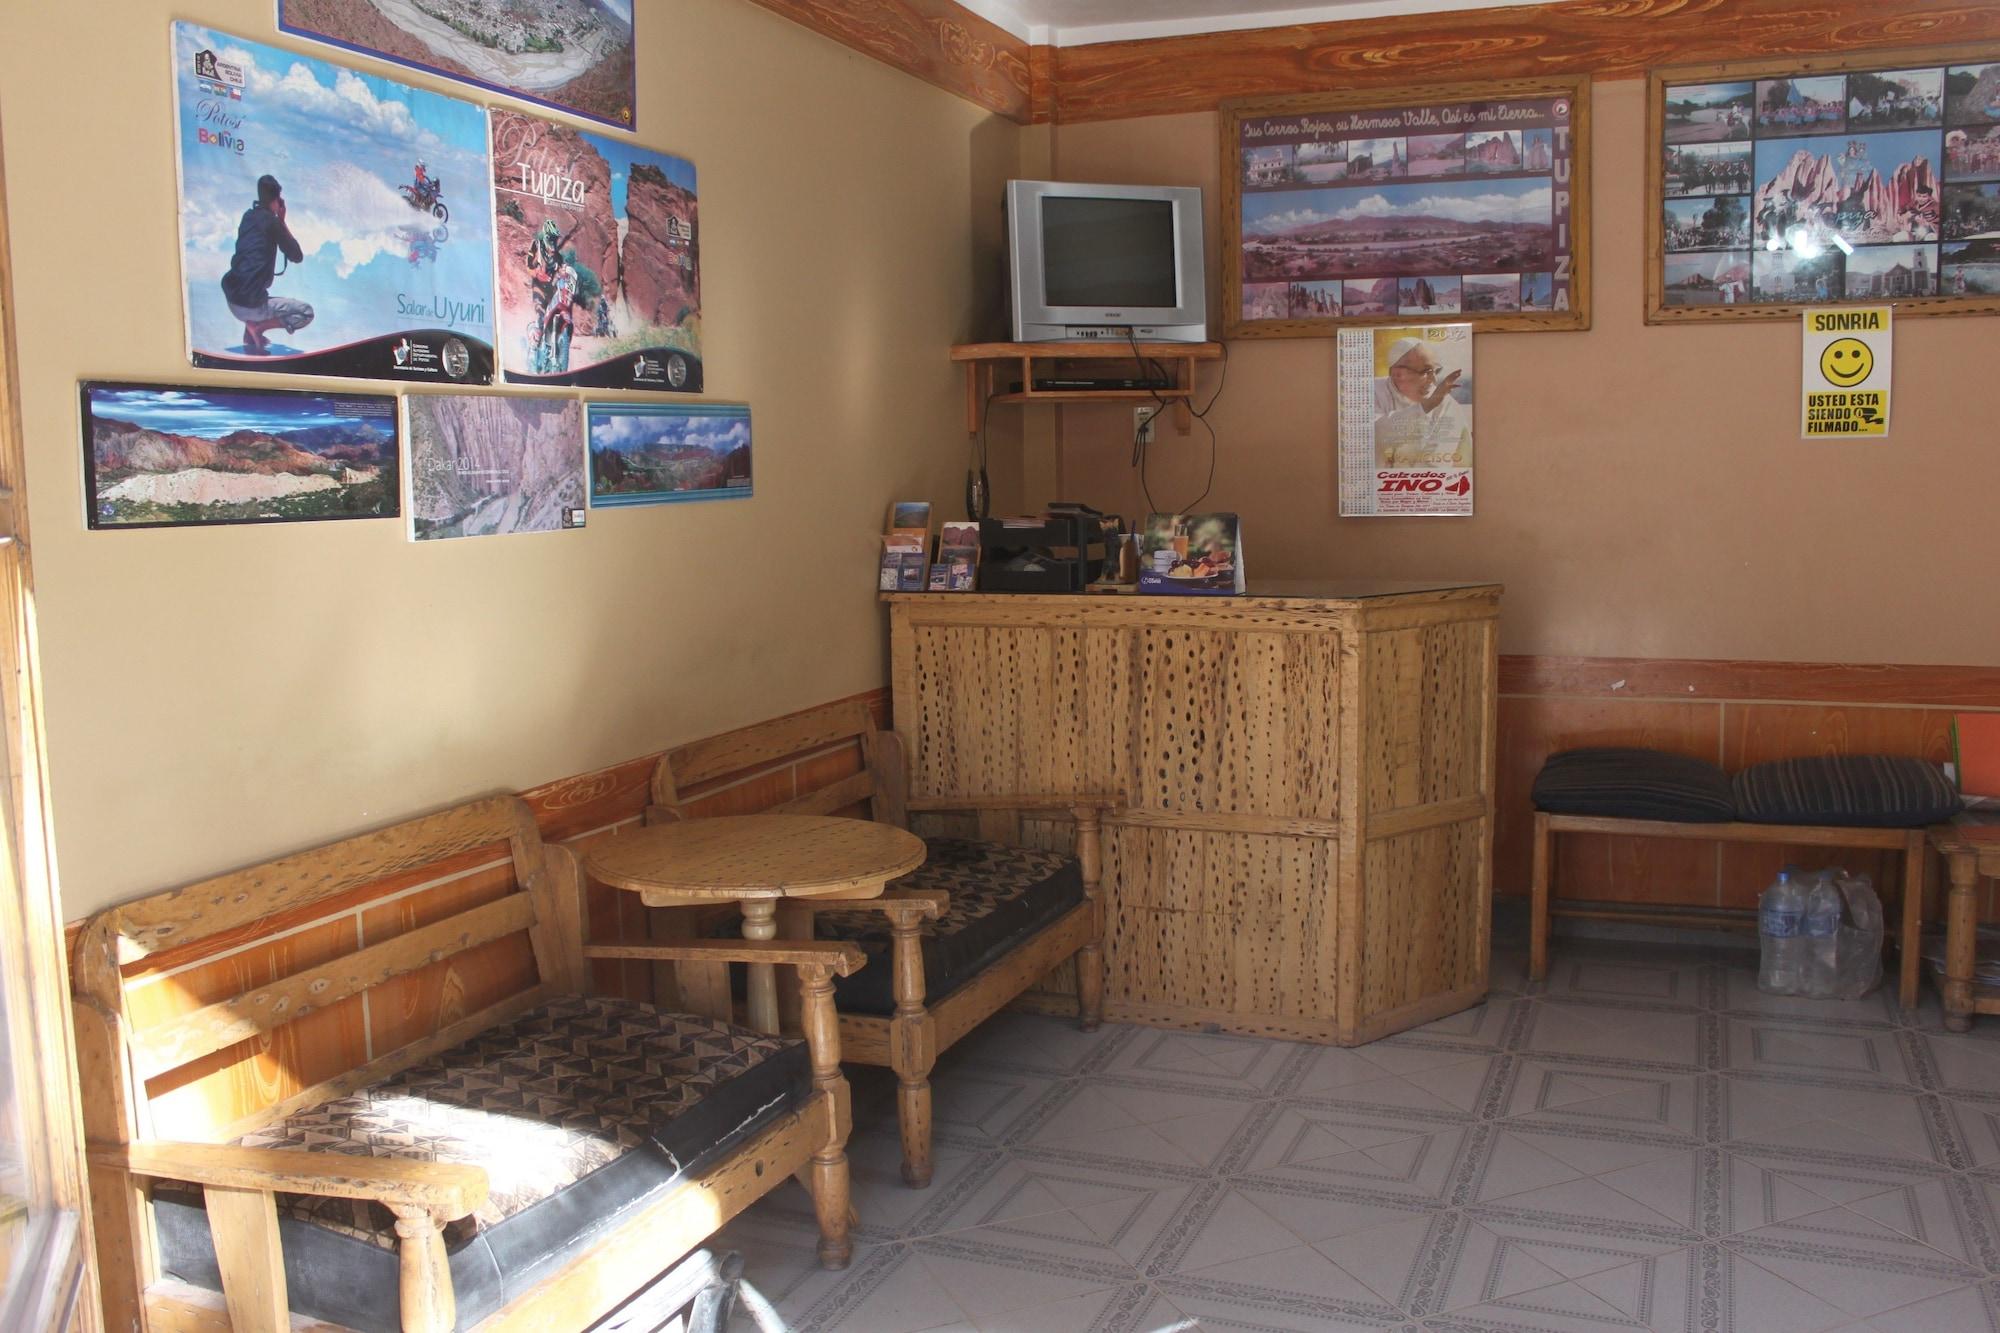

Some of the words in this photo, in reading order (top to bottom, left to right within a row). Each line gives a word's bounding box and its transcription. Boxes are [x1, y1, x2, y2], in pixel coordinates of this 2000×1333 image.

[1264, 121, 1299, 137] Cerros
[1301, 118, 1334, 139] Rojos,
[1336, 121, 1349, 131] su
[1350, 114, 1400, 131] Hermoso
[1402, 108, 1440, 127] Valle,
[1463, 112, 1476, 123] es
[516, 162, 585, 205] Tupiza
[1554, 126, 1570, 311] TUPIZA
[397, 293, 427, 316] Salar
[434, 295, 485, 327] Uyuni
[1815, 312, 1880, 331] SONRIA
[1808, 394, 1847, 407] USTED
[1850, 393, 1880, 406] ESTA
[1808, 407, 1851, 420] SIENDO
[427, 457, 458, 472] Dakar
[1377, 471, 1447, 479] Calzados
[1377, 479, 1443, 492] INO
